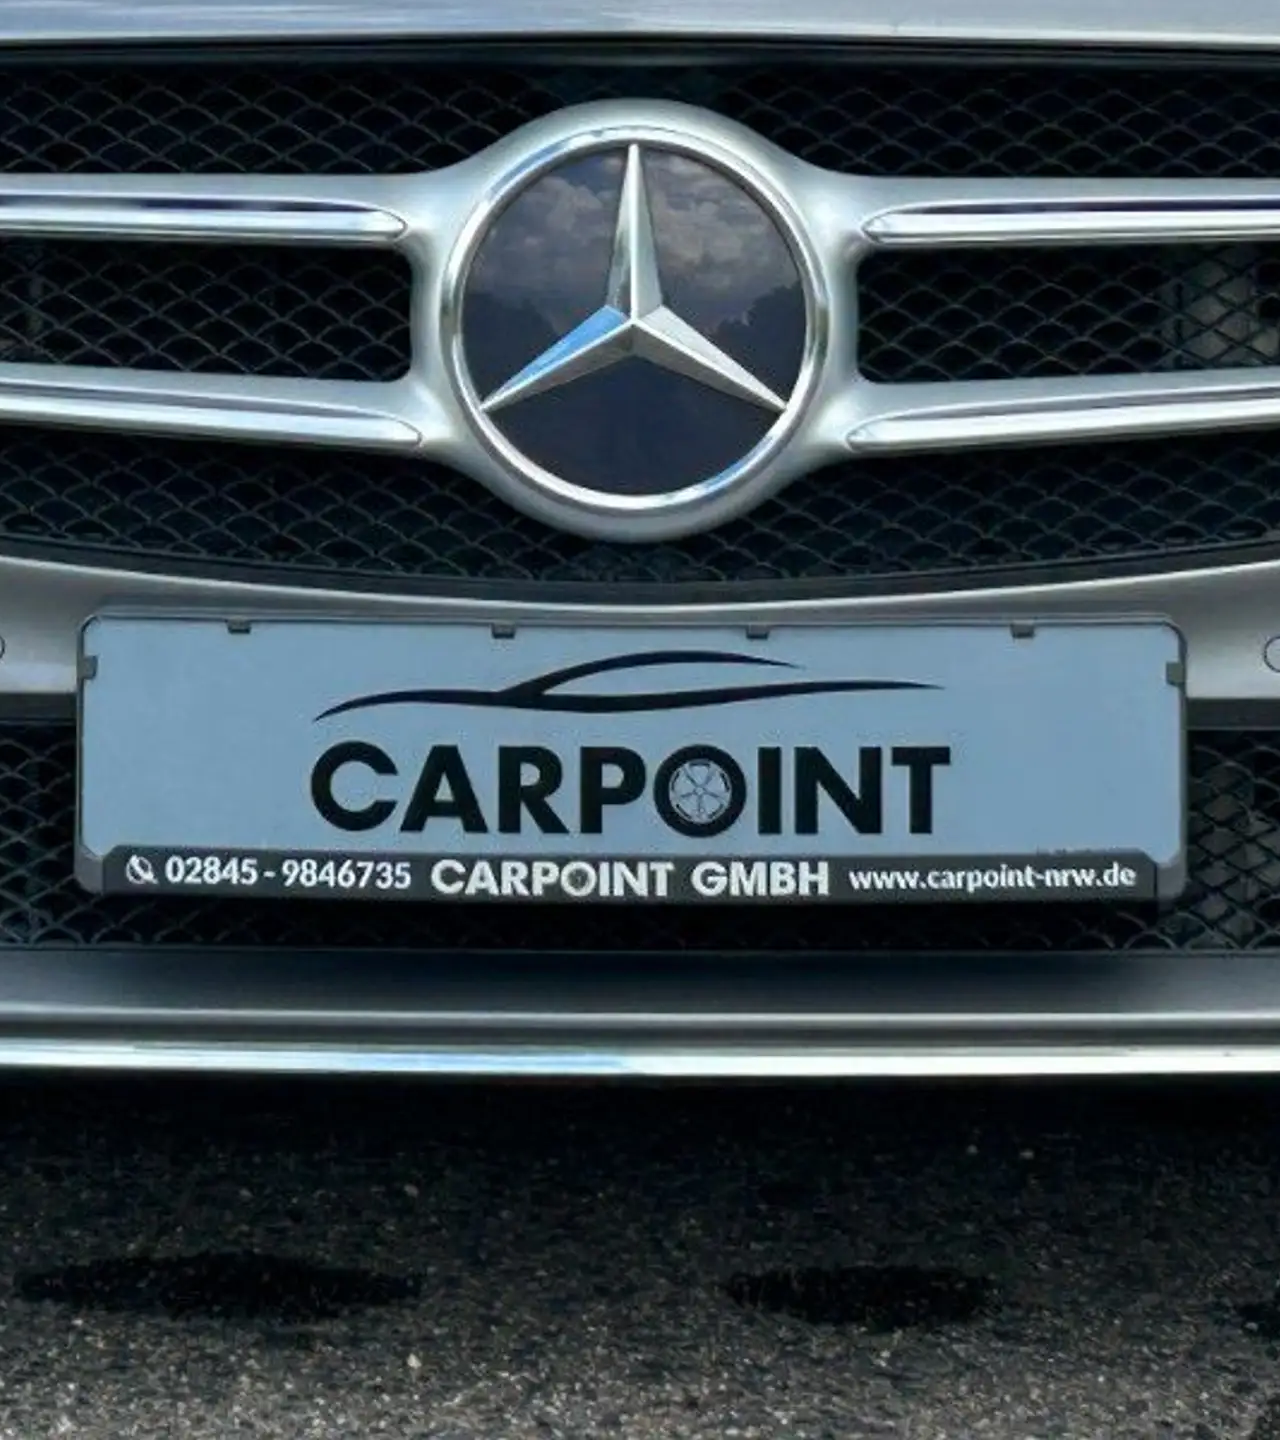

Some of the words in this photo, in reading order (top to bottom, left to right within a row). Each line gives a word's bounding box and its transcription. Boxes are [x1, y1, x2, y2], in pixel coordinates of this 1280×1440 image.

[310, 741, 951, 839] CARPOINT
[430, 859, 675, 897] CARPOINT
[690, 860, 829, 897] GMBH
[848, 860, 1137, 894] www.carpoint-nrw.de
